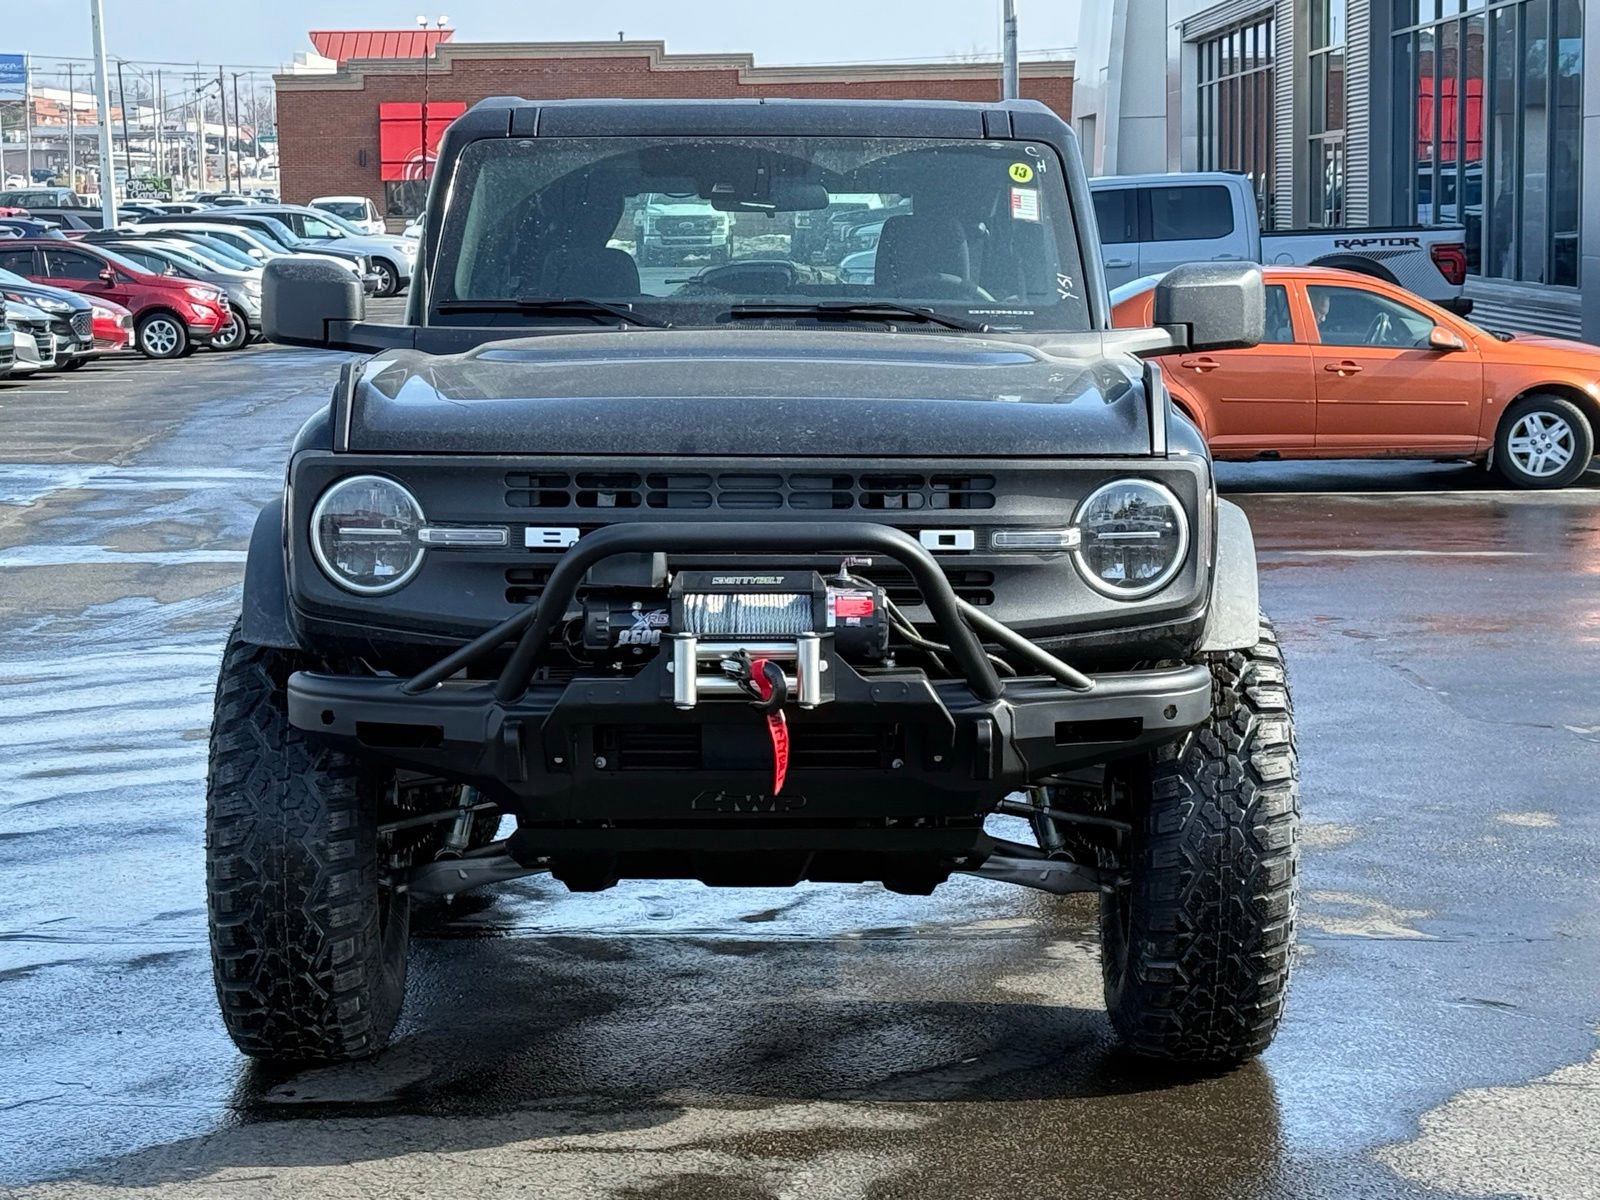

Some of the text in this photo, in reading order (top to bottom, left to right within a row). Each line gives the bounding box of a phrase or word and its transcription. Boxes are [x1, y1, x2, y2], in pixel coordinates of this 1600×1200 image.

[1014, 166, 1028, 178] 13
[126, 180, 155, 191] Olive
[130, 189, 172, 199] Garden
[1334, 237, 1423, 250] RAPTOR
[711, 576, 785, 585] SMITTYBILT
